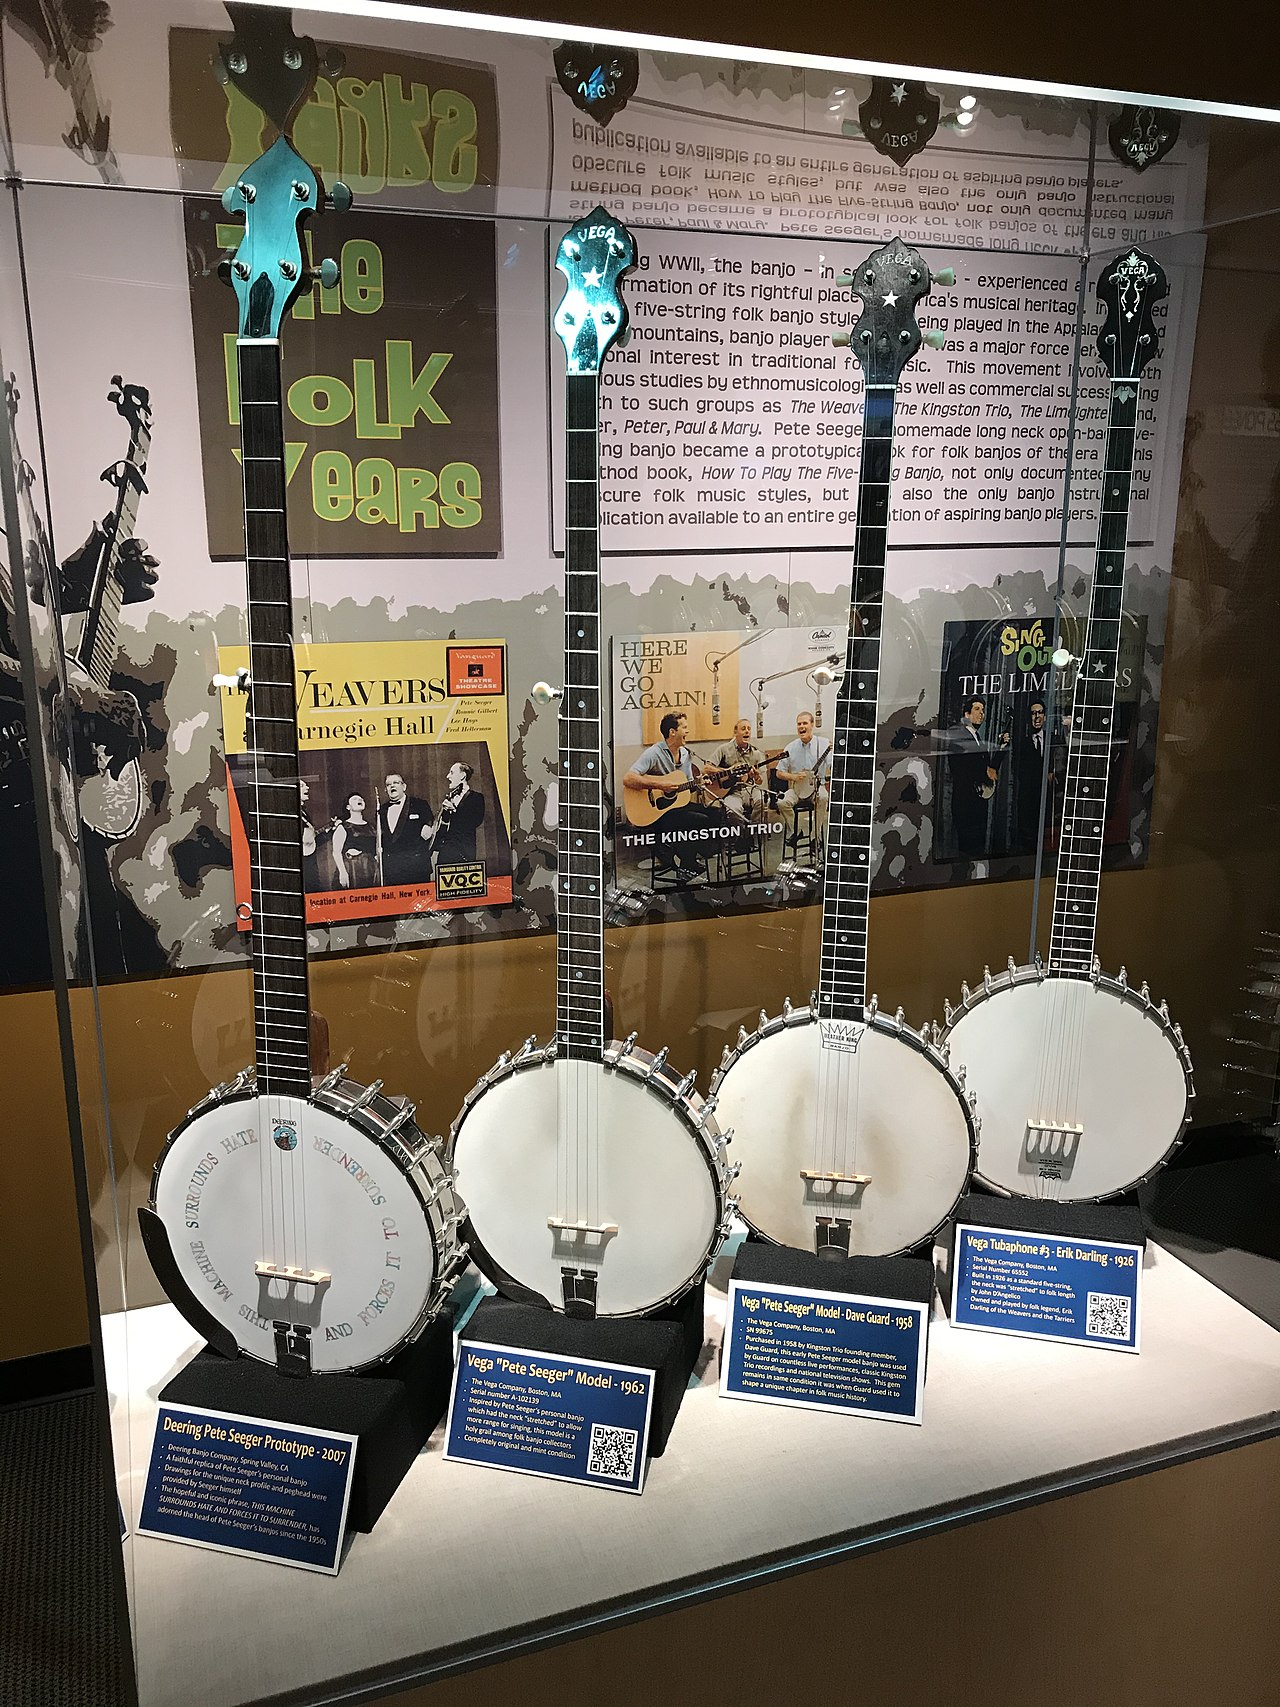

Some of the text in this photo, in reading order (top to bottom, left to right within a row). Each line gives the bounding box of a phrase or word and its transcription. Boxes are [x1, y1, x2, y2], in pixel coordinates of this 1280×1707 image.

[578, 225, 616, 243] VEGA
[875, 252, 912, 267] VEGA
[1121, 266, 1145, 275] VEGA
[659, 255, 1068, 291] WWII, the banjo in experienced
[699, 282, 1020, 310] of its rightful musical
[634, 302, 1049, 333] five-string folk banjo played in the
[629, 325, 1069, 355] mountains, banjo player major force
[650, 350, 1061, 376] interest in traditional This movement
[640, 373, 1054, 397] studies by well as commercial
[621, 396, 1042, 419] to such groups as The The Kingston Trio, The
[624, 420, 1044, 440] Peter, Paul Mary. Pete long neck
[631, 443, 1098, 460] banjo became for folk banjos of era
[648, 466, 1013, 482] book, How To Play The Banjo, not only
[654, 487, 1054, 503] folk music styles, but also the only banjo
[669, 508, 1041, 524] available to an entire of aspiring banjo
[620, 640, 688, 657] HERE
[621, 658, 663, 674] WE
[620, 676, 654, 692] GO
[959, 675, 1002, 696] THE
[621, 691, 706, 710] AGAIN!
[298, 715, 434, 743] arnegie Hall
[623, 822, 783, 847] THE KINGSTON TRIO
[350, 894, 378, 903] Carnegie
[381, 892, 396, 900] Hall,
[399, 890, 412, 898] New
[185, 1129, 270, 1332] THIS MACHINE SURROUNDS HATE
[312, 1135, 401, 1342] AND FORCES IT TO SURRENDER
[967, 1236, 1134, 1267] Vega Tubaphone #3 Erik Darling 1926
[741, 1295, 760, 1312] Vega
[815, 1305, 841, 1319] Model
[845, 1308, 865, 1322] Dave
[866, 1311, 890, 1326] Guard
[895, 1315, 913, 1329] 1958
[467, 1353, 494, 1373] Vega
[576, 1374, 612, 1389] Model
[620, 1380, 645, 1395] 1962
[471, 1377, 483, 1386] The
[483, 1379, 498, 1389] Vega
[470, 1387, 487, 1396] Serial
[487, 1389, 510, 1400] number
[163, 1417, 346, 1466] Deering Pete Seeger Prototype 2007
[168, 1444, 191, 1455] Deering
[192, 1448, 210, 1458] Banjo
[240, 1456, 259, 1468] Spring
[280, 1464, 289, 1472] CA
